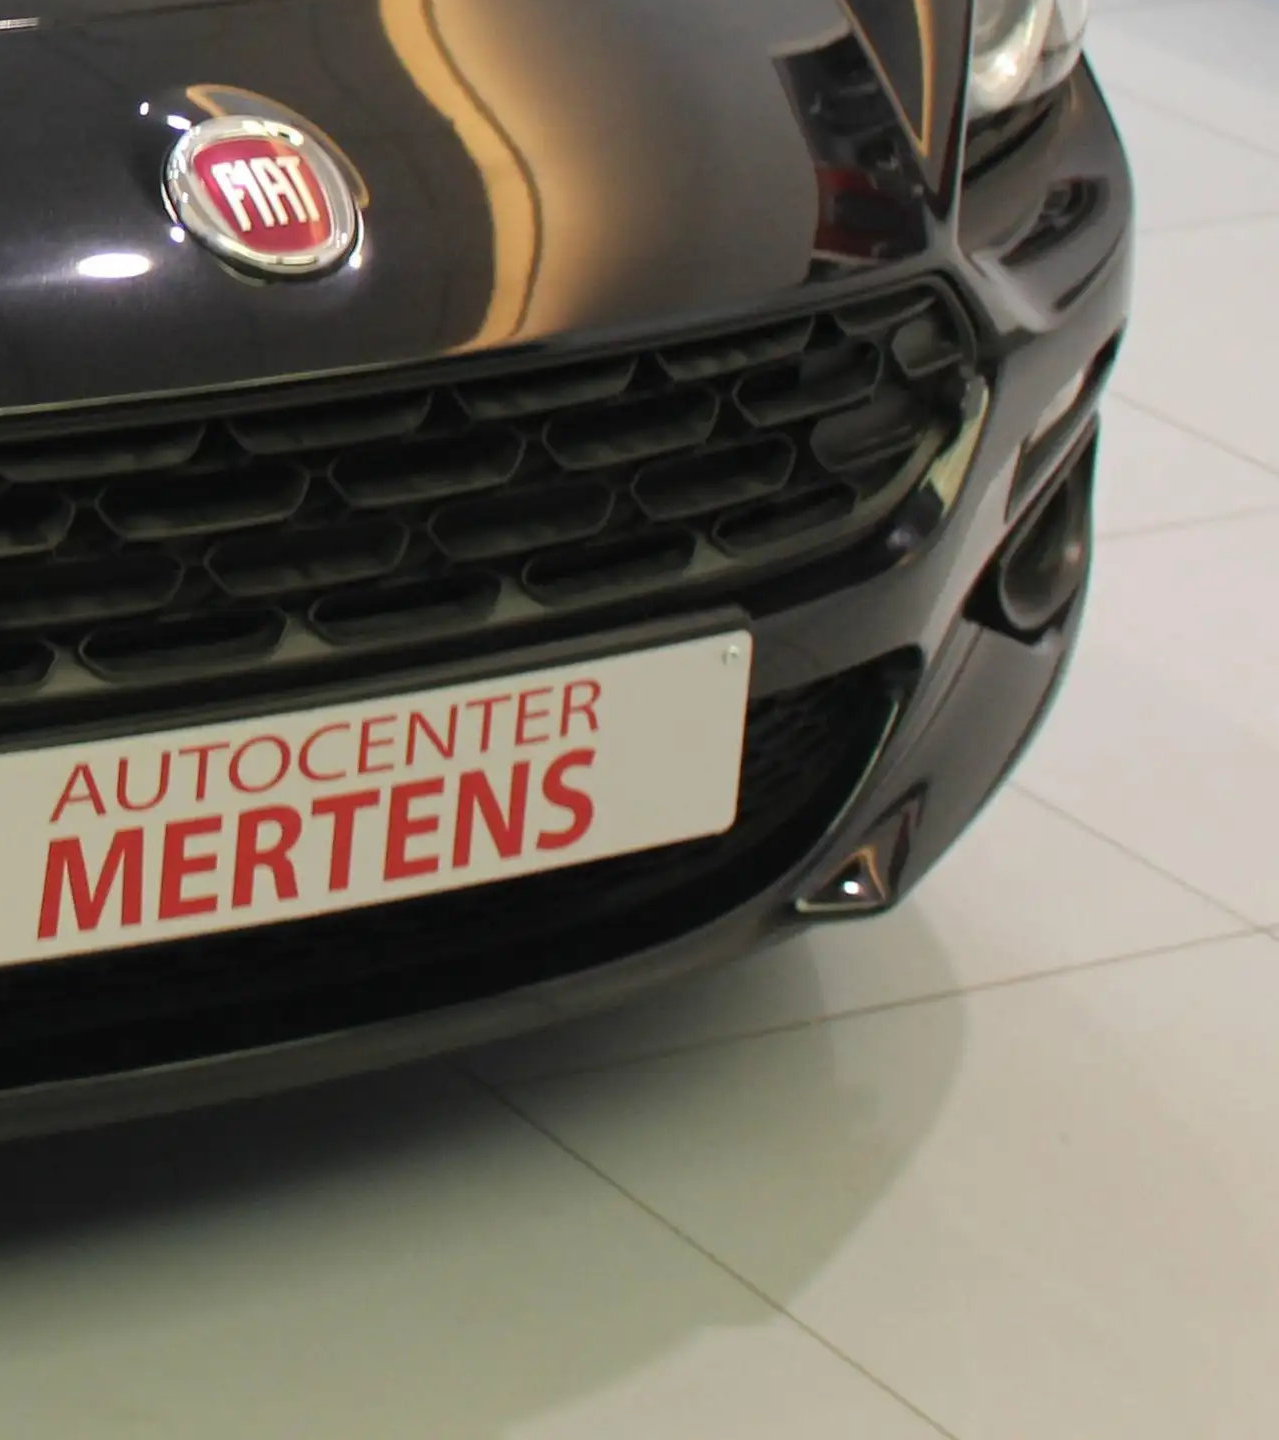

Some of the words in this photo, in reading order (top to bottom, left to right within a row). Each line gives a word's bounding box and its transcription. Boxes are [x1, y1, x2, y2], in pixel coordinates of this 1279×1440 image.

[210, 155, 321, 232] FIAT
[49, 678, 602, 824] AUTOCENTER
[36, 746, 596, 941] MERTENS
